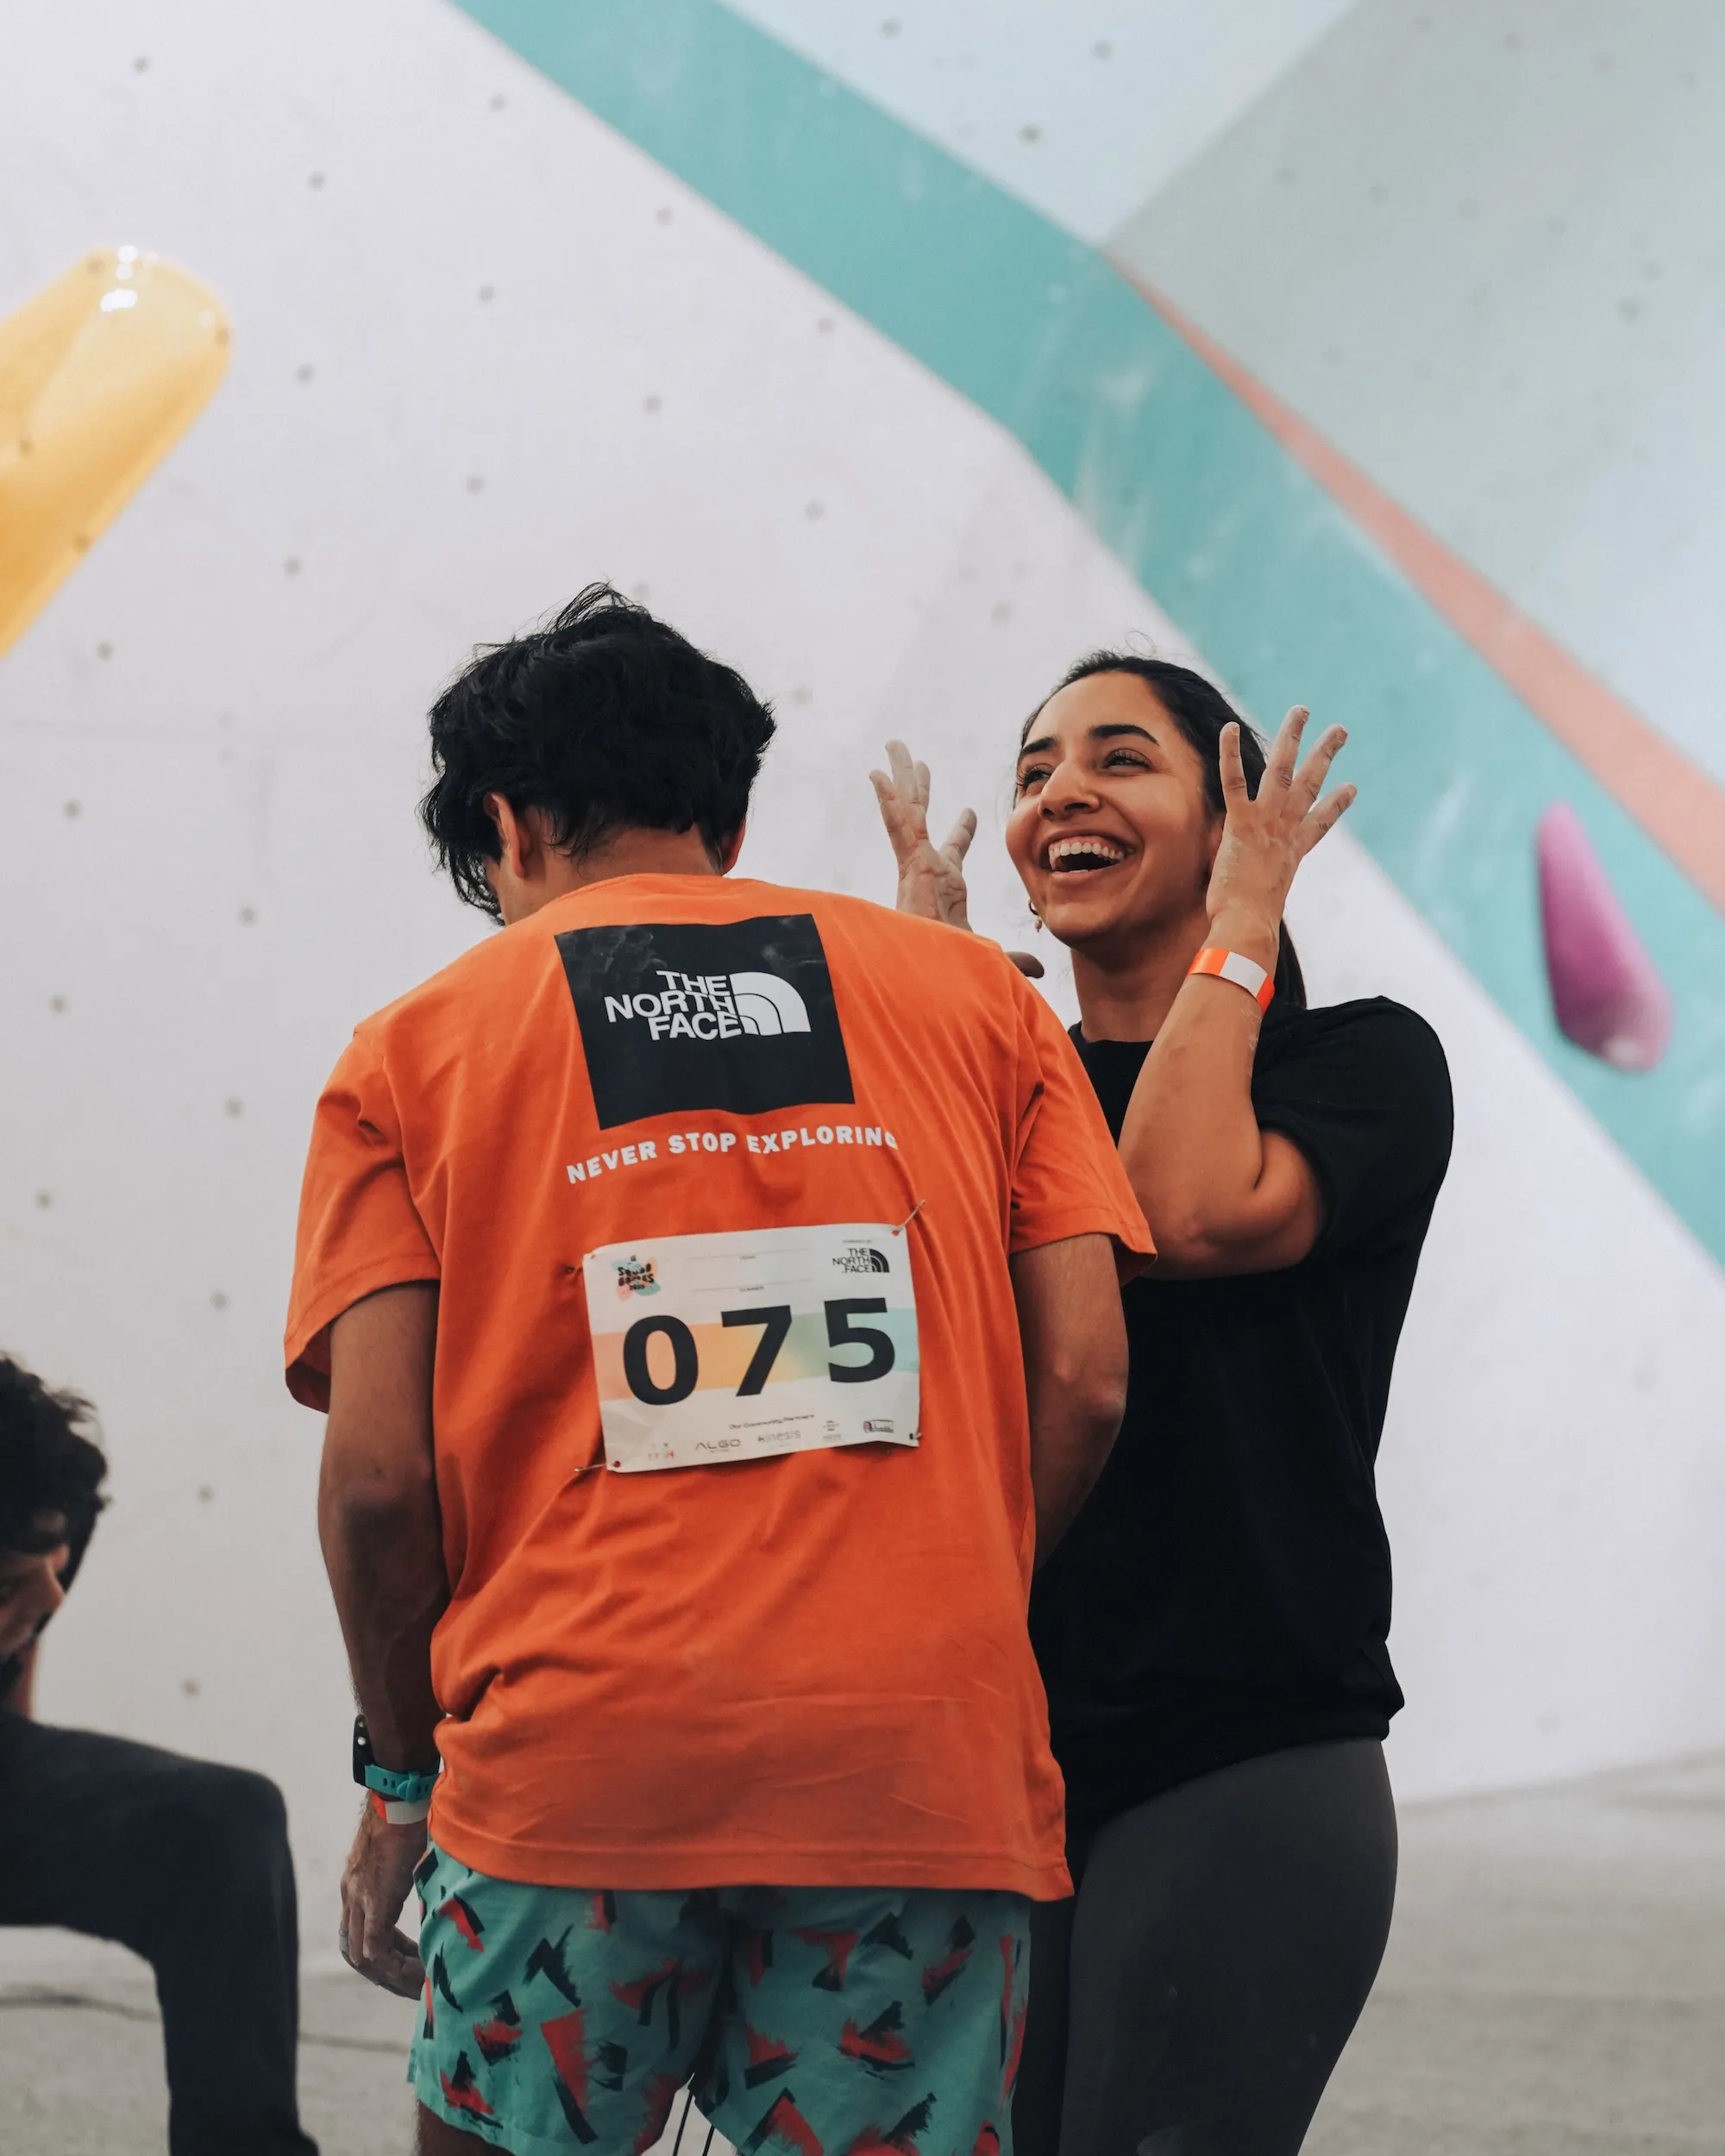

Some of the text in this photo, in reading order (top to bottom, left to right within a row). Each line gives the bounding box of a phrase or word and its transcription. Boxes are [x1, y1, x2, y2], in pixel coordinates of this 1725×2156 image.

[656, 970, 731, 997] THE
[604, 989, 736, 1023] NORTH
[648, 1010, 742, 1041] FACE
[566, 1140, 657, 1185] NEVER
[668, 1132, 737, 1154] STOP
[832, 1256, 870, 1267] NORTH
[848, 1248, 868, 1257] THE
[842, 1265, 871, 1274] FACE
[694, 1438, 741, 1452] ALGO
